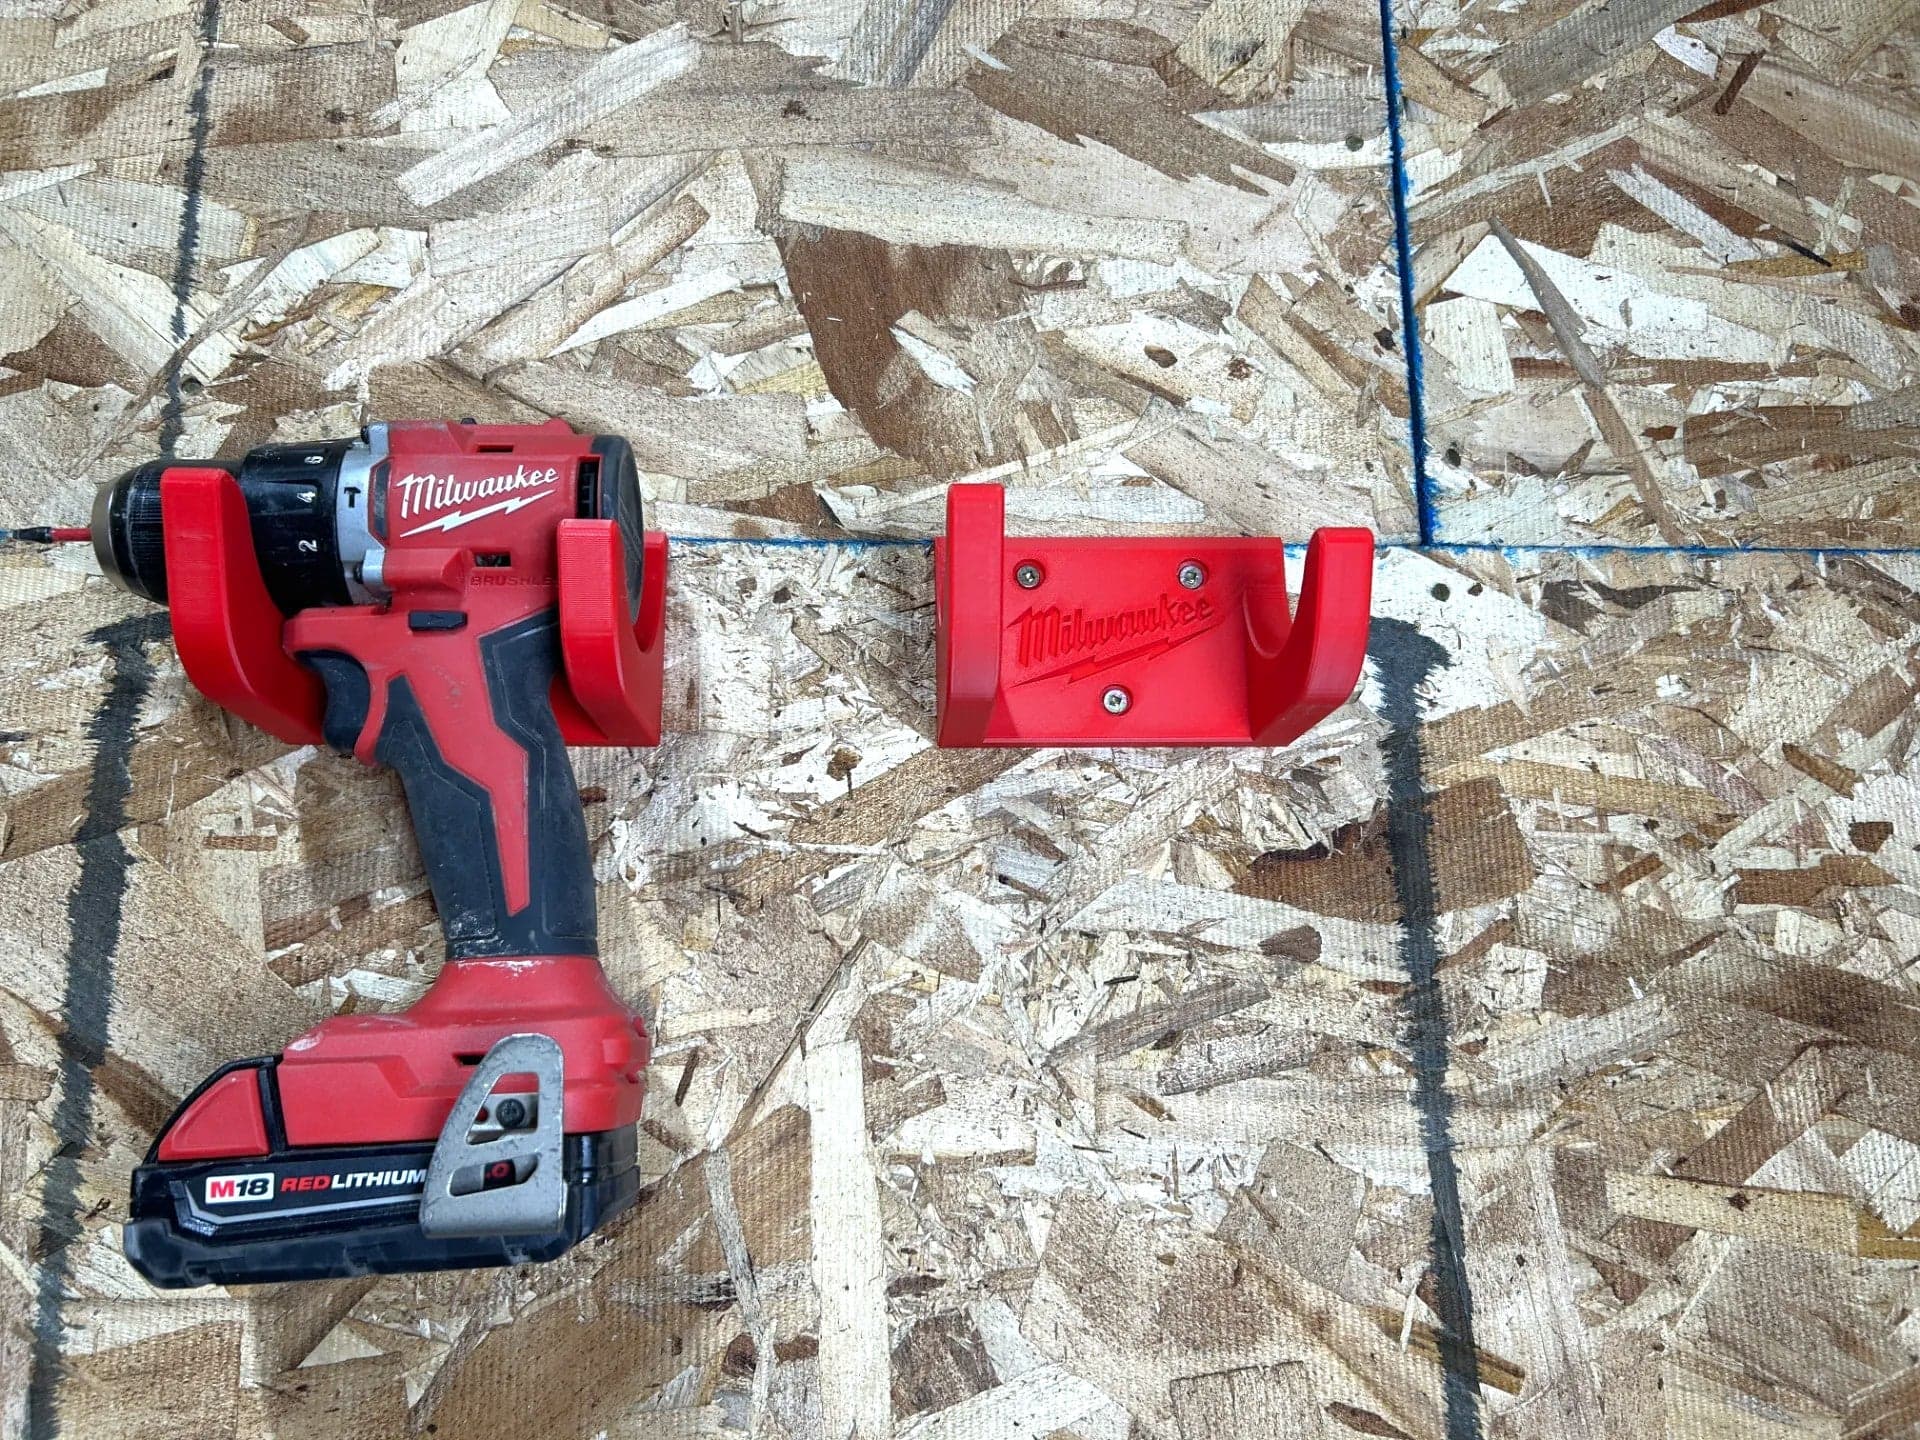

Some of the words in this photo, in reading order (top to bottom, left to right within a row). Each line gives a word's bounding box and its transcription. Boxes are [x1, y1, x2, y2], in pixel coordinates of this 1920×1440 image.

[296, 491, 316, 503] 4
[397, 464, 560, 518] Milwaukee
[298, 539, 318, 552] 2
[1007, 592, 1212, 668] Milwaukee
[209, 1177, 271, 1198] M18
